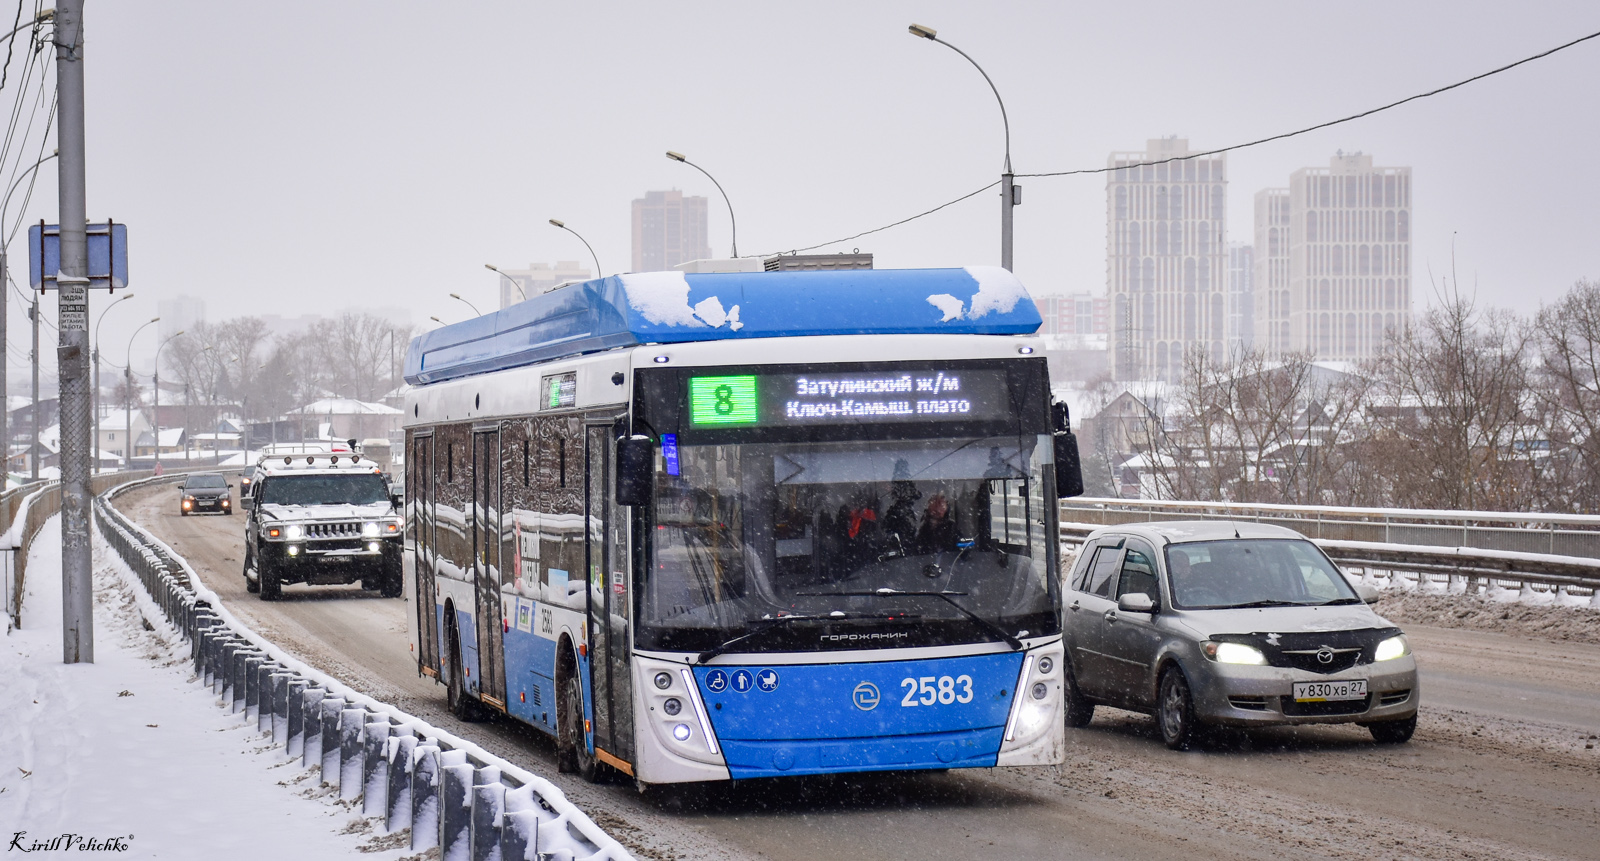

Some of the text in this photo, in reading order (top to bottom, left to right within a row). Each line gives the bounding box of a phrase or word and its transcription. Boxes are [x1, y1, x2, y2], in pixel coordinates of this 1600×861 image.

[796, 372, 960, 397] Затулинский ж/м
[714, 384, 734, 416] 8
[917, 398, 970, 414] плато
[541, 608, 553, 635] 2583
[820, 632, 908, 641] ГОРОЖАНИН
[900, 674, 974, 707] 2583
[1351, 682, 1363, 692] 27
